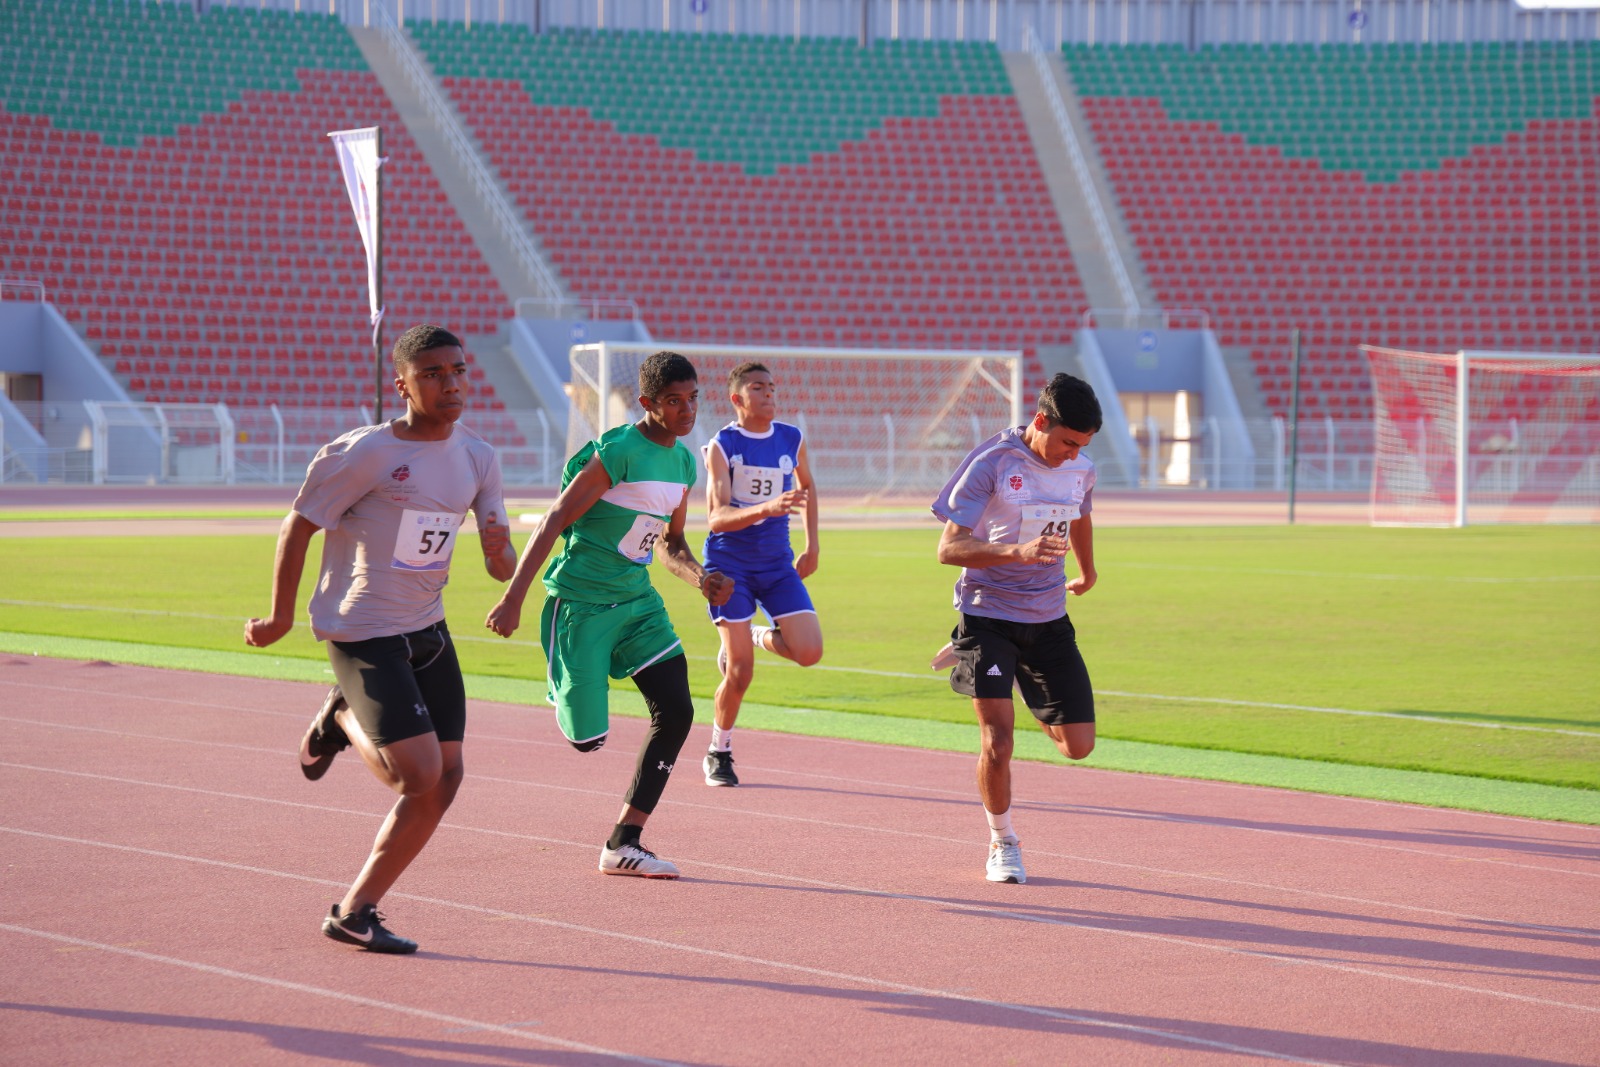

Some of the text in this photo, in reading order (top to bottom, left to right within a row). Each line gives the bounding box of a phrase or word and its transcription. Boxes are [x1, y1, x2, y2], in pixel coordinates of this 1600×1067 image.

[750, 479, 773, 496] 33
[1040, 521, 1067, 538] 49
[418, 530, 450, 554] 57
